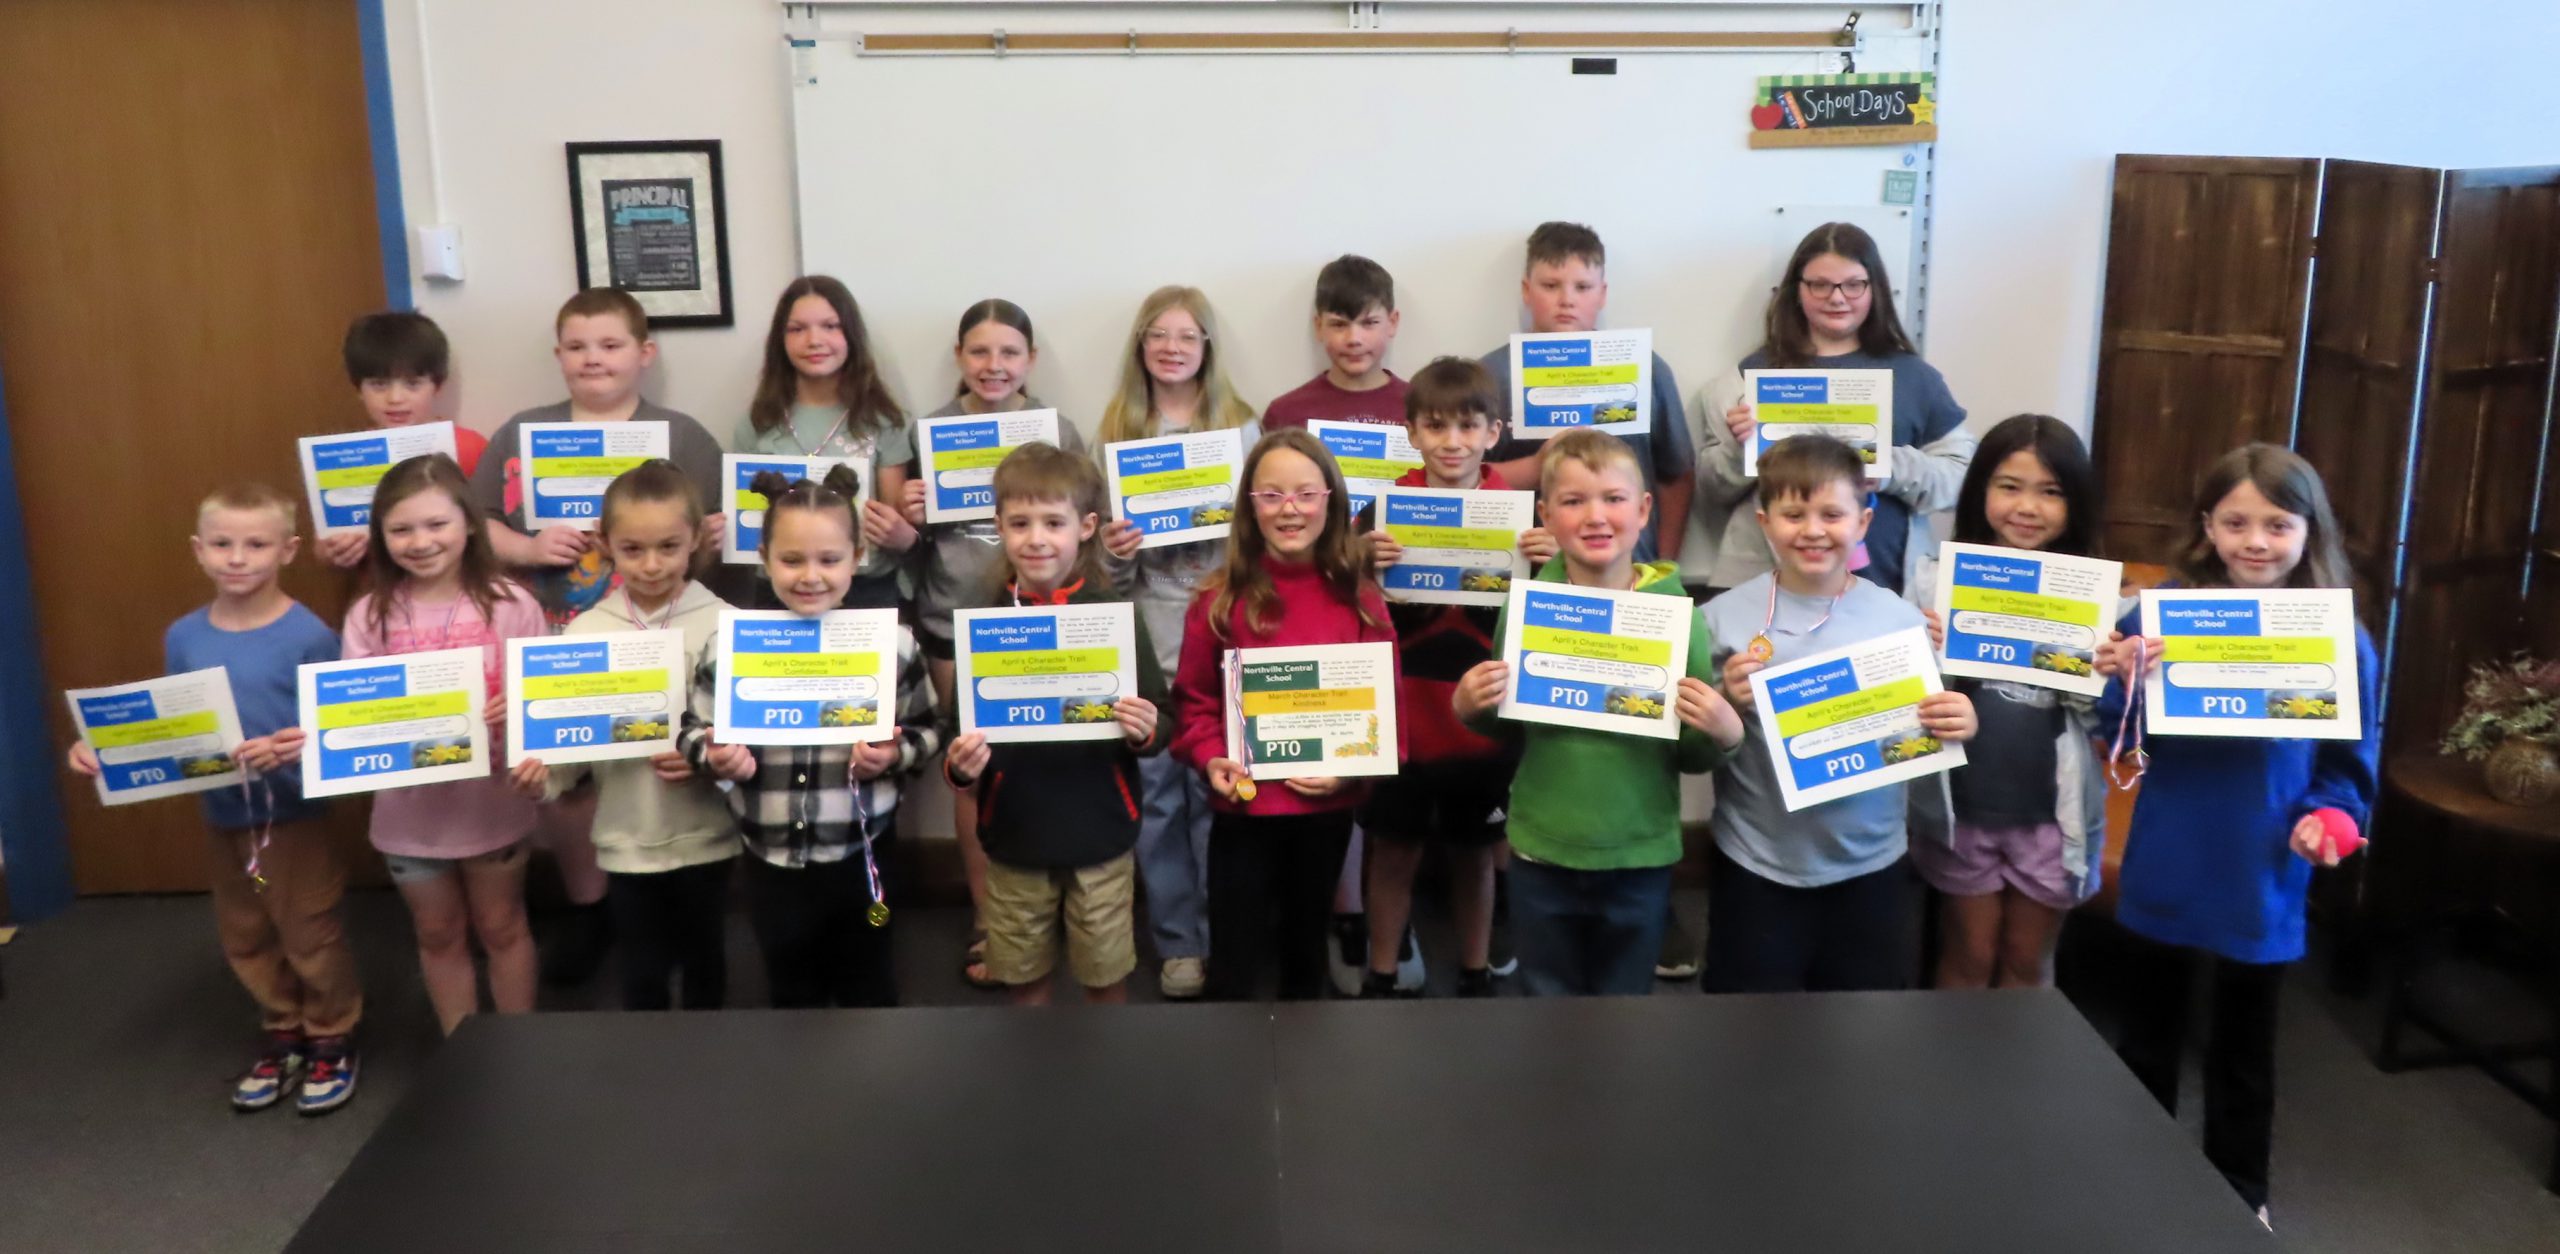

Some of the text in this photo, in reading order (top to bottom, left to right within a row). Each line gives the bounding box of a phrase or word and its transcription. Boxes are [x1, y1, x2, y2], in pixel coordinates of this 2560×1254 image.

[610, 186, 689, 210] PRINCIPAL
[1551, 411, 1580, 423] PTO
[1122, 455, 1154, 463] Northville
[963, 491, 991, 504] PTO
[562, 502, 592, 514] PTO
[1392, 504, 1428, 512] Northville
[1151, 516, 1178, 530] PTO
[1960, 562, 2034, 576] Northville Central
[1412, 573, 1444, 587] PTO
[1982, 574, 2010, 582] School
[1532, 601, 1607, 616] Northville Central
[2167, 610, 2214, 618] Northville
[1554, 614, 1582, 623] School
[2194, 620, 2226, 628] School
[740, 629, 782, 637] Northville
[976, 625, 1050, 635] Northville Central
[529, 651, 602, 661] Northville Central
[1978, 643, 2015, 661] PTO
[1244, 664, 1313, 674] Northville Central
[1775, 668, 1848, 694] Northville Central
[1551, 687, 1588, 706] PTO
[1800, 684, 1828, 698] School
[2203, 696, 2246, 714] PTO
[765, 709, 802, 725] PTO
[1009, 706, 1045, 722] PTO
[556, 727, 592, 743] PTO
[1267, 740, 1300, 757] PTO
[354, 754, 393, 772] PTO
[1826, 753, 1864, 777] PTO
[129, 768, 165, 785] PTO
